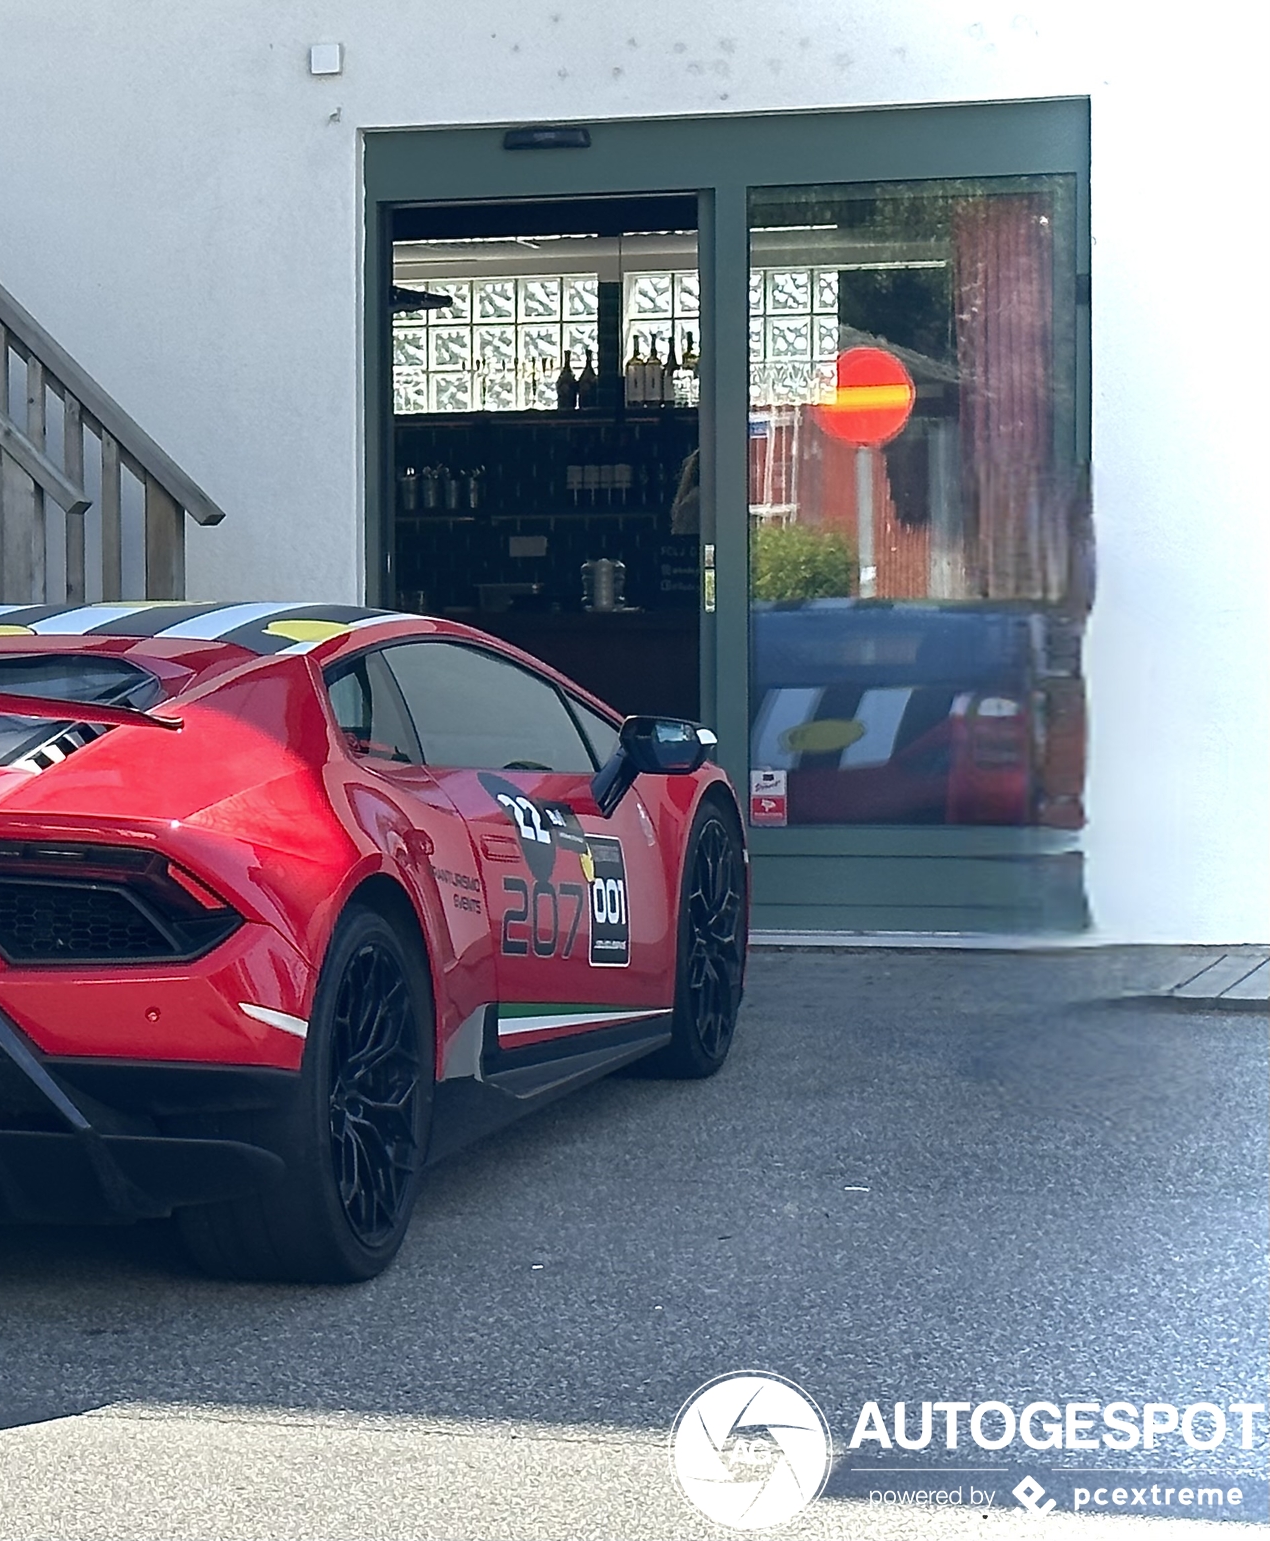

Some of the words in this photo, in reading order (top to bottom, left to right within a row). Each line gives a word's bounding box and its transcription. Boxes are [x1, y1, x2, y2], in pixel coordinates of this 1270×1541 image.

[497, 793, 551, 844] 22
[453, 893, 482, 915] EVENTS
[501, 874, 584, 960] 207
[592, 877, 626, 925] 001
